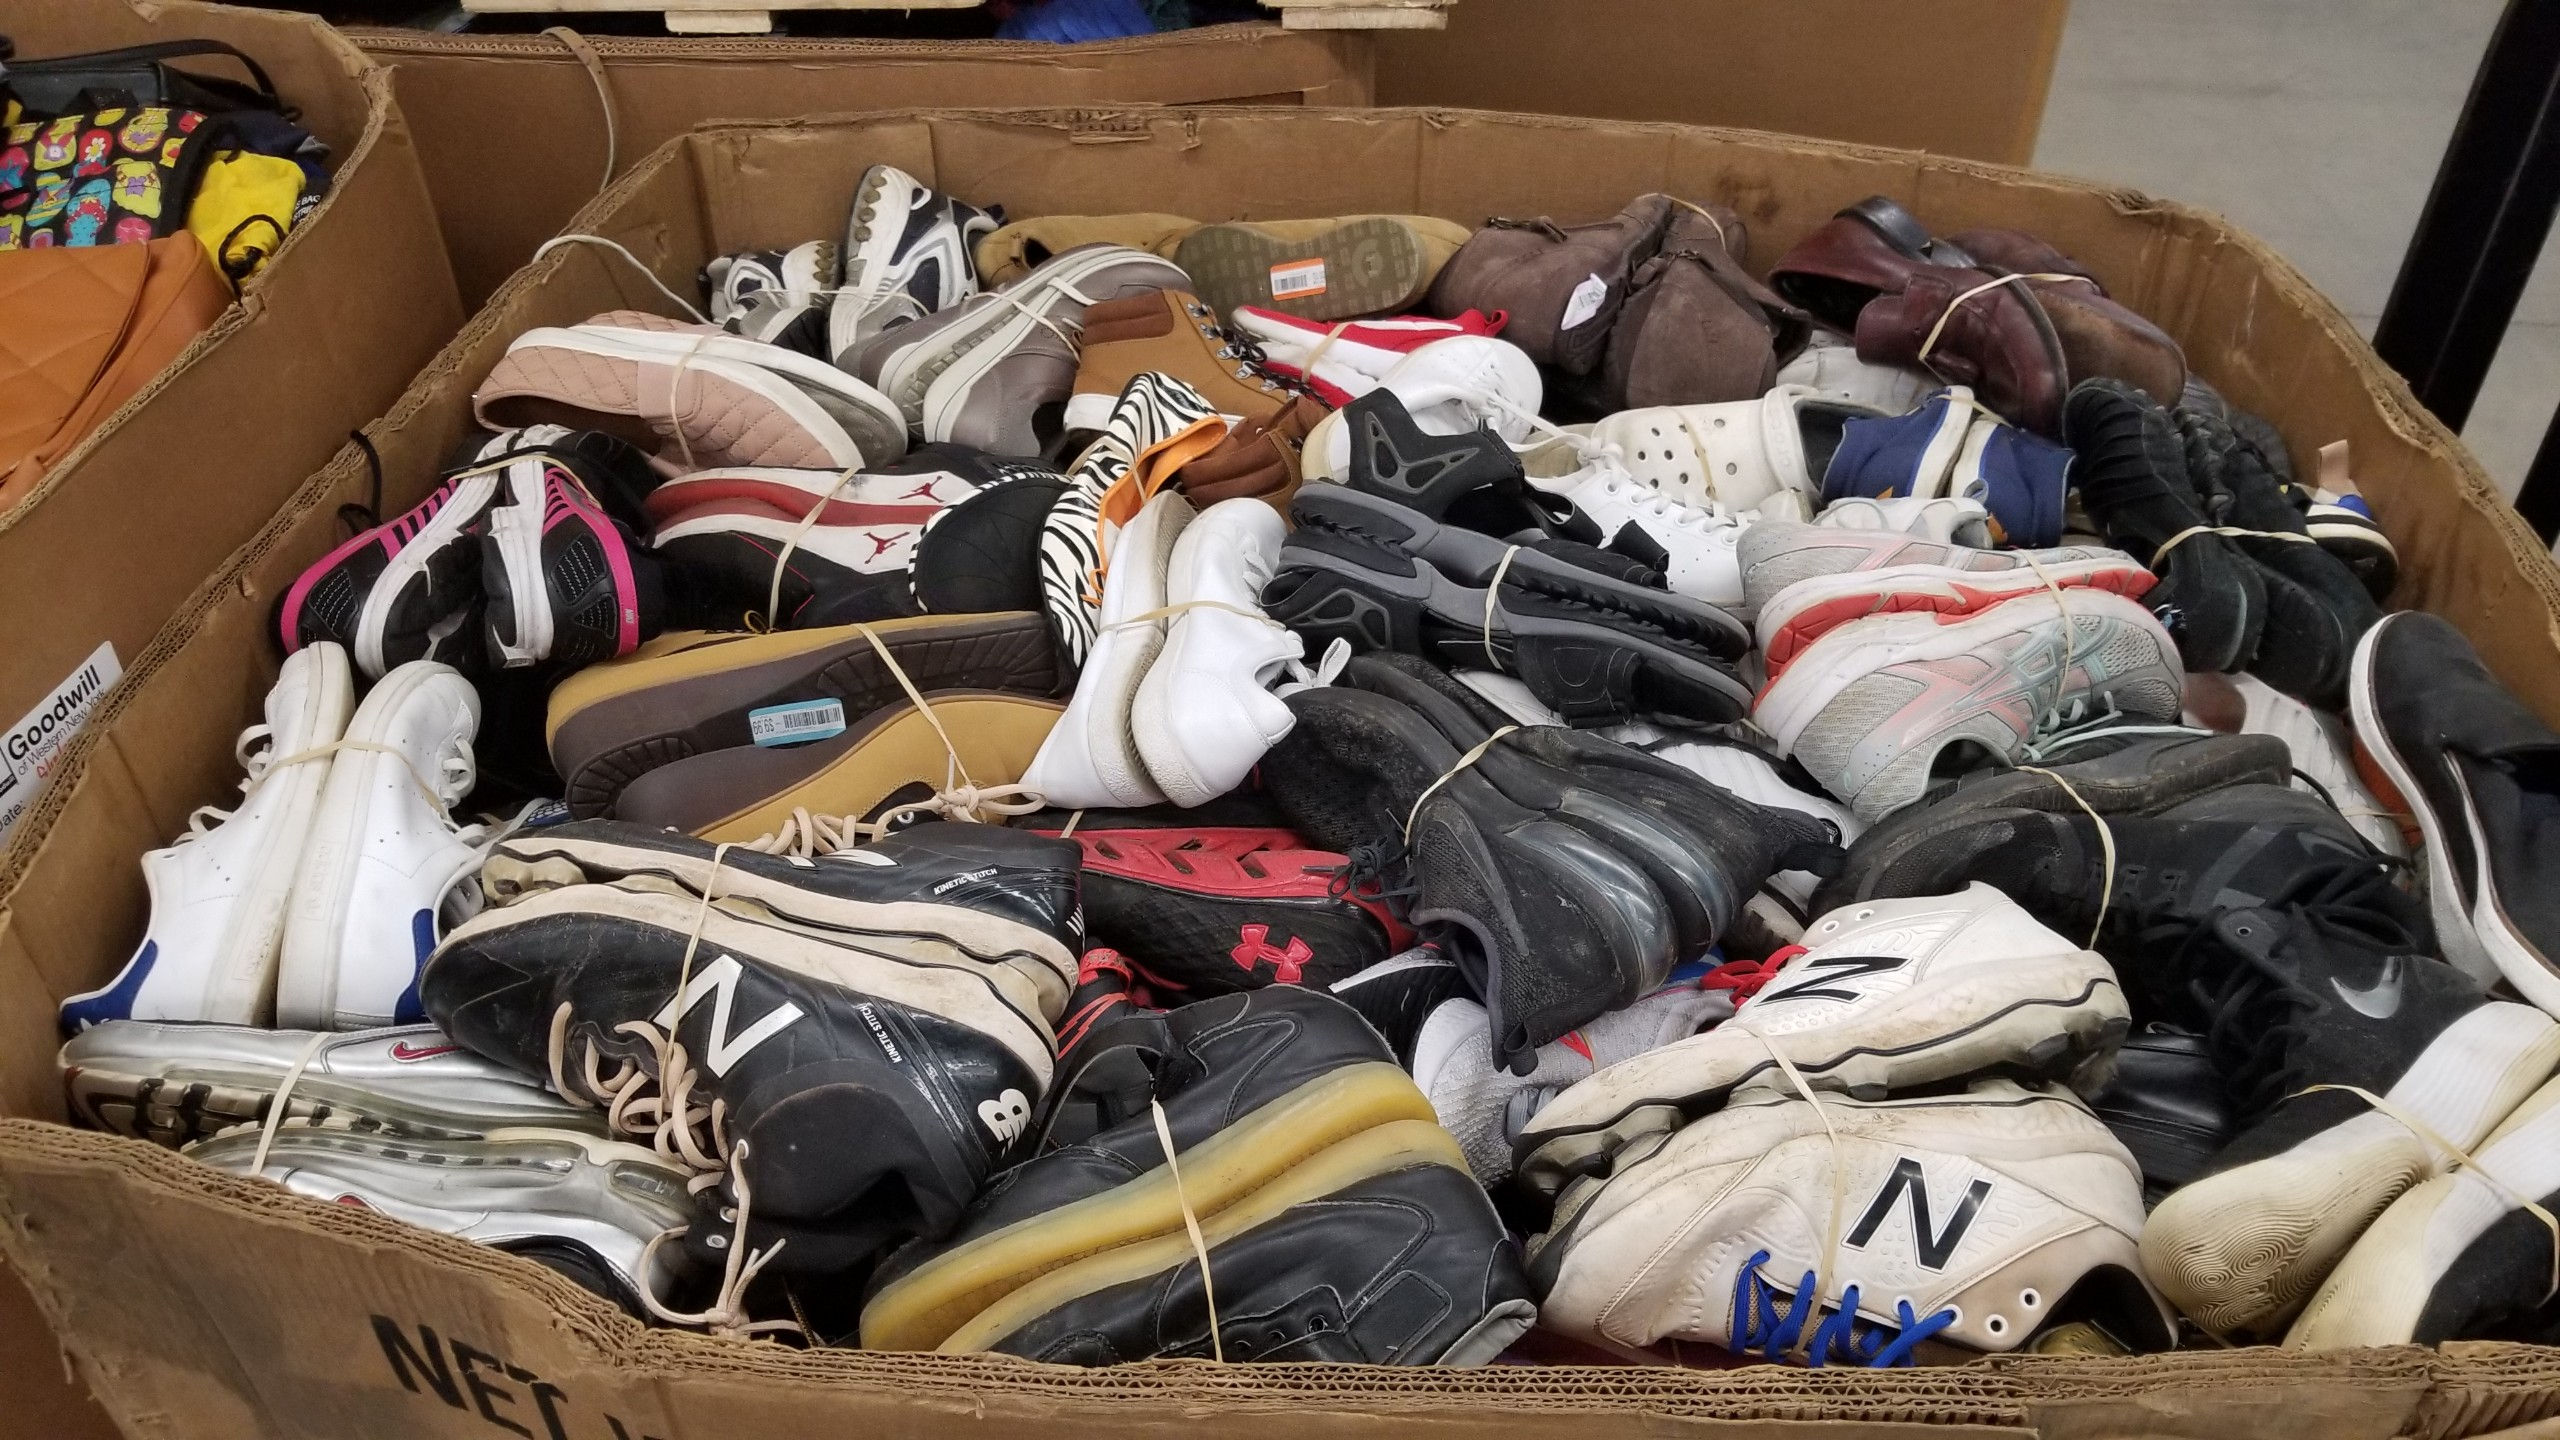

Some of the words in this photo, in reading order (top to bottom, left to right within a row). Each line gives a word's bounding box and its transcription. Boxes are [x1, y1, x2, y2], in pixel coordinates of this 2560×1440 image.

[8, 664, 101, 761] Goodwill
[25, 728, 68, 766] Western
[64, 709, 88, 732] New
[933, 876, 968, 895] KINETIC
[1757, 956, 1908, 1003] N
[653, 954, 804, 1078] N
[859, 1003, 882, 1032] STITCH
[876, 1030, 903, 1064] KINETIC
[1844, 1155, 1993, 1271] N
[370, 1314, 568, 1440] NET
